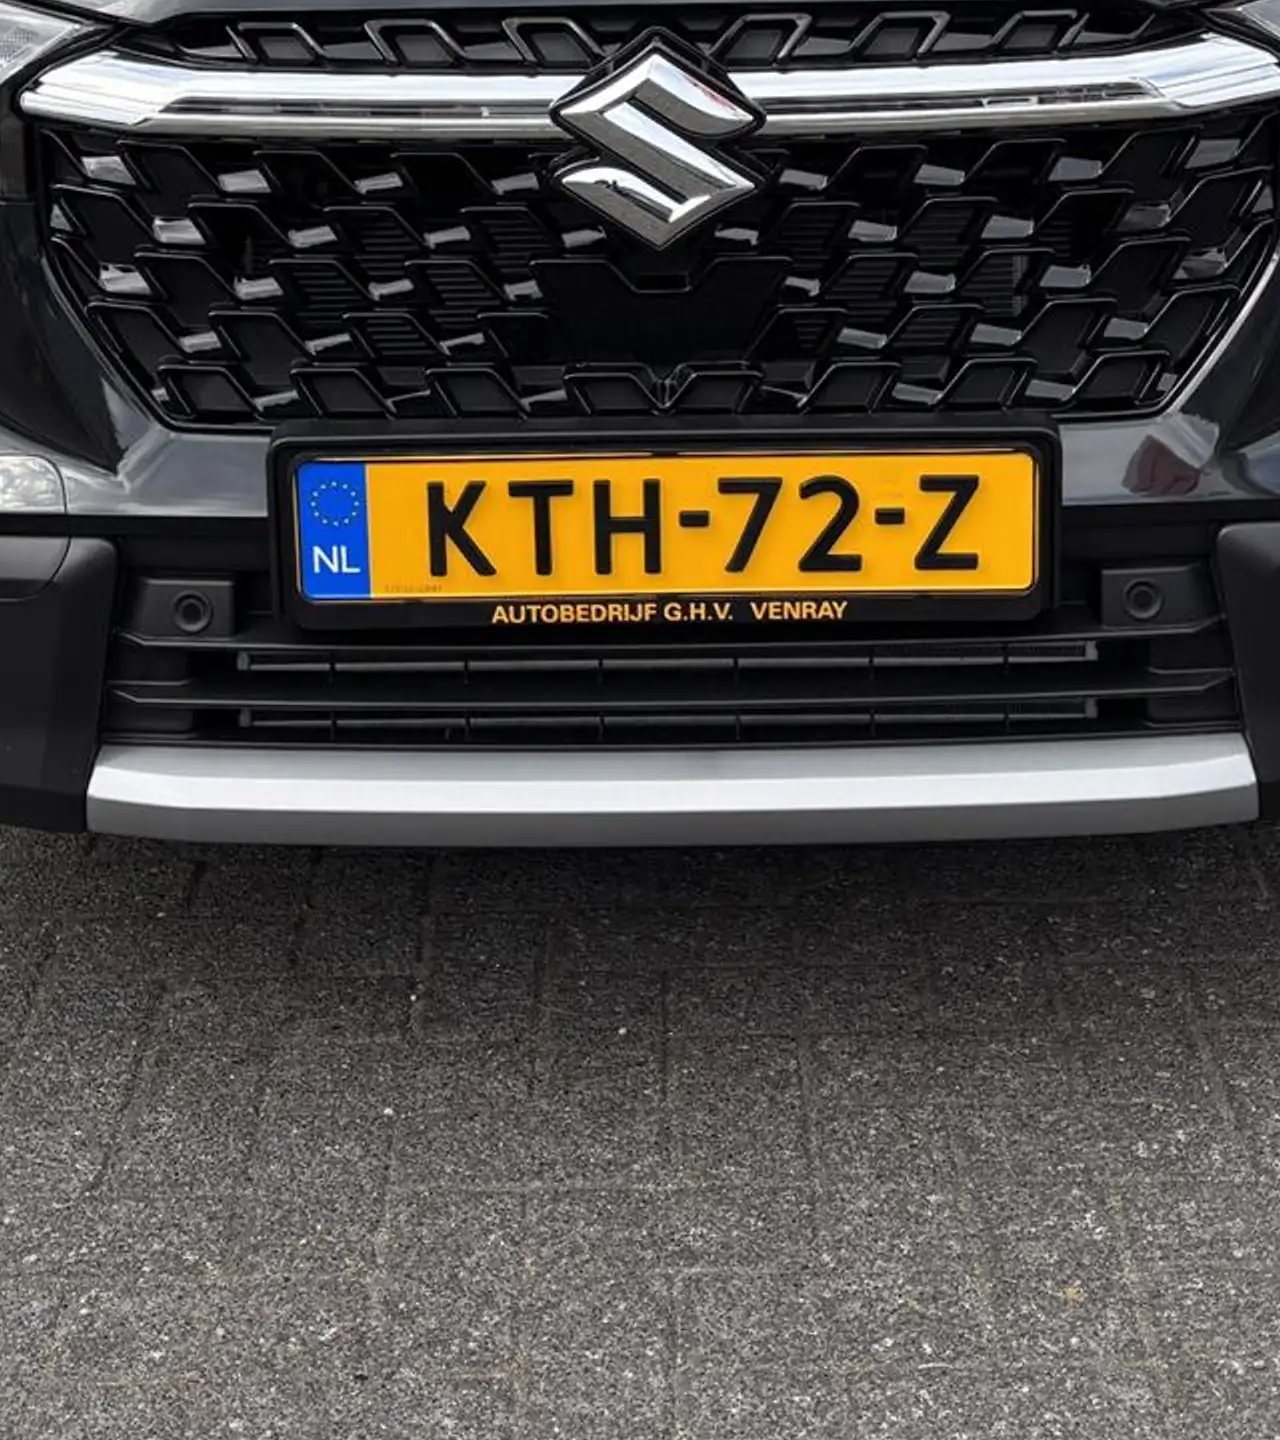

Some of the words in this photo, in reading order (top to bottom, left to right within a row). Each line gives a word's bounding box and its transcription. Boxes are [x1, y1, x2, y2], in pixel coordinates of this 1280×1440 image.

[426, 474, 980, 578] KTH-72-Z
[312, 545, 361, 574] NL
[490, 603, 658, 624] AUTOBEDRIJF
[663, 602, 734, 622] G.H.V.
[750, 600, 849, 621] VENRAY
